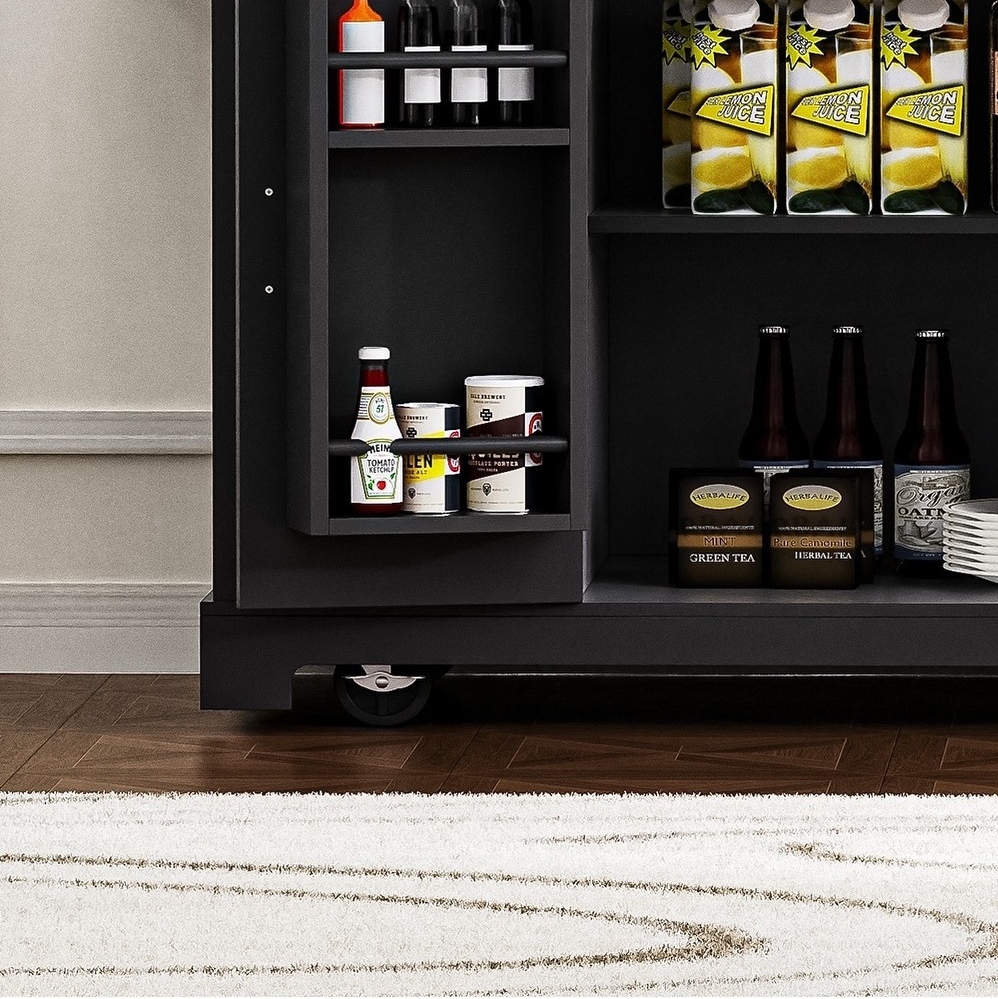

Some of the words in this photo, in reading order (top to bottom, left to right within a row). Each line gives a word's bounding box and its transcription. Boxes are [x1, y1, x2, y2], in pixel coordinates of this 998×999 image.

[719, 91, 768, 106] LEMON
[814, 91, 864, 106] LEMON
[909, 91, 958, 106] LEMON
[717, 105, 767, 125] JUICE
[812, 105, 861, 124] JUICE
[907, 105, 956, 124] JUICE
[367, 458, 396, 467] TOMATO
[692, 492, 747, 503] HERBALIFE
[785, 493, 840, 504] HERBALIFE
[703, 536, 737, 547] MINT
[773, 537, 797, 548] Pure
[800, 536, 853, 548] Camomile
[689, 553, 730, 563] GREEN
[731, 553, 756, 563] TEA
[794, 551, 833, 560] HERBAL
[833, 551, 853, 560] TEA
